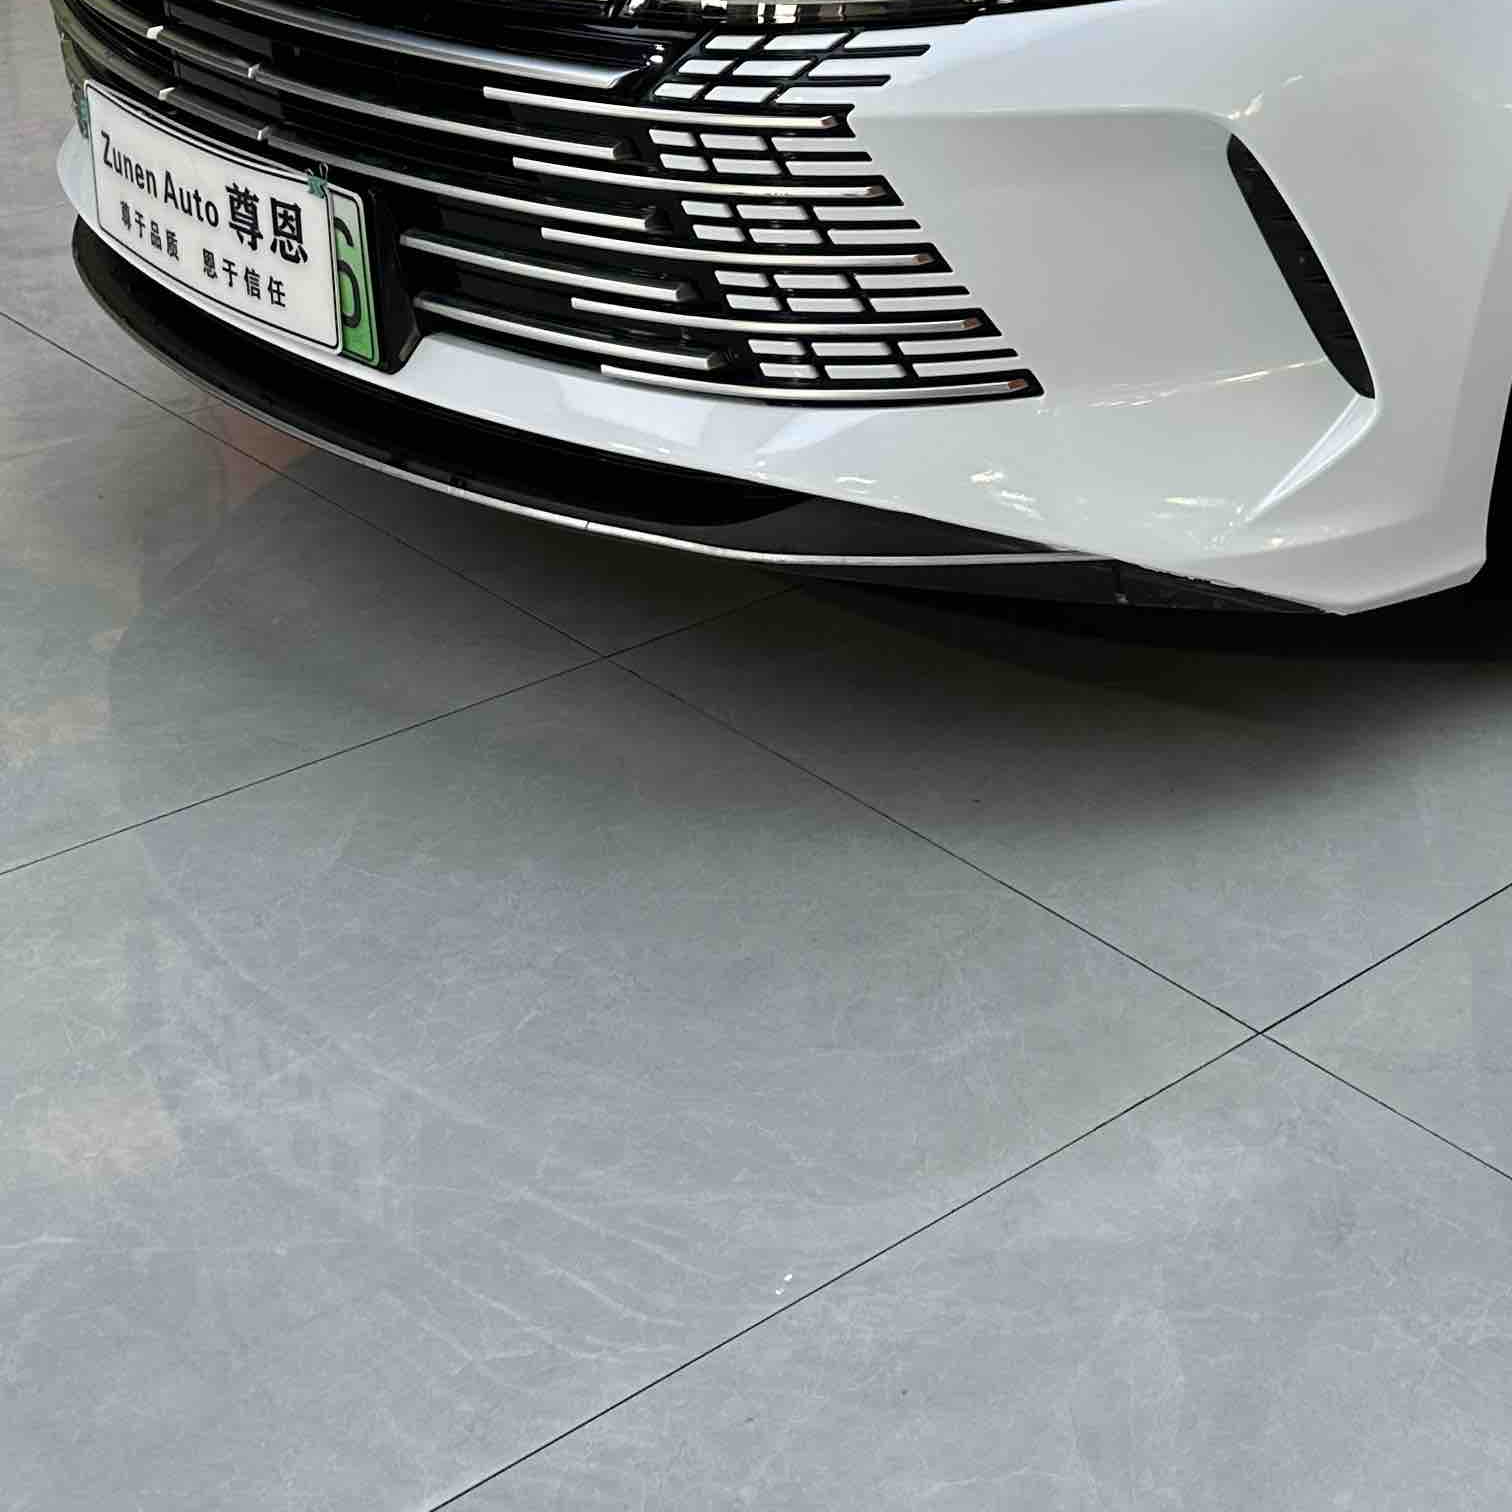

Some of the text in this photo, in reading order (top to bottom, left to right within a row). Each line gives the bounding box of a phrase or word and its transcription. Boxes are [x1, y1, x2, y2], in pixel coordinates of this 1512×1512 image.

[101, 129, 309, 264] Zunen Auto 尊恩
